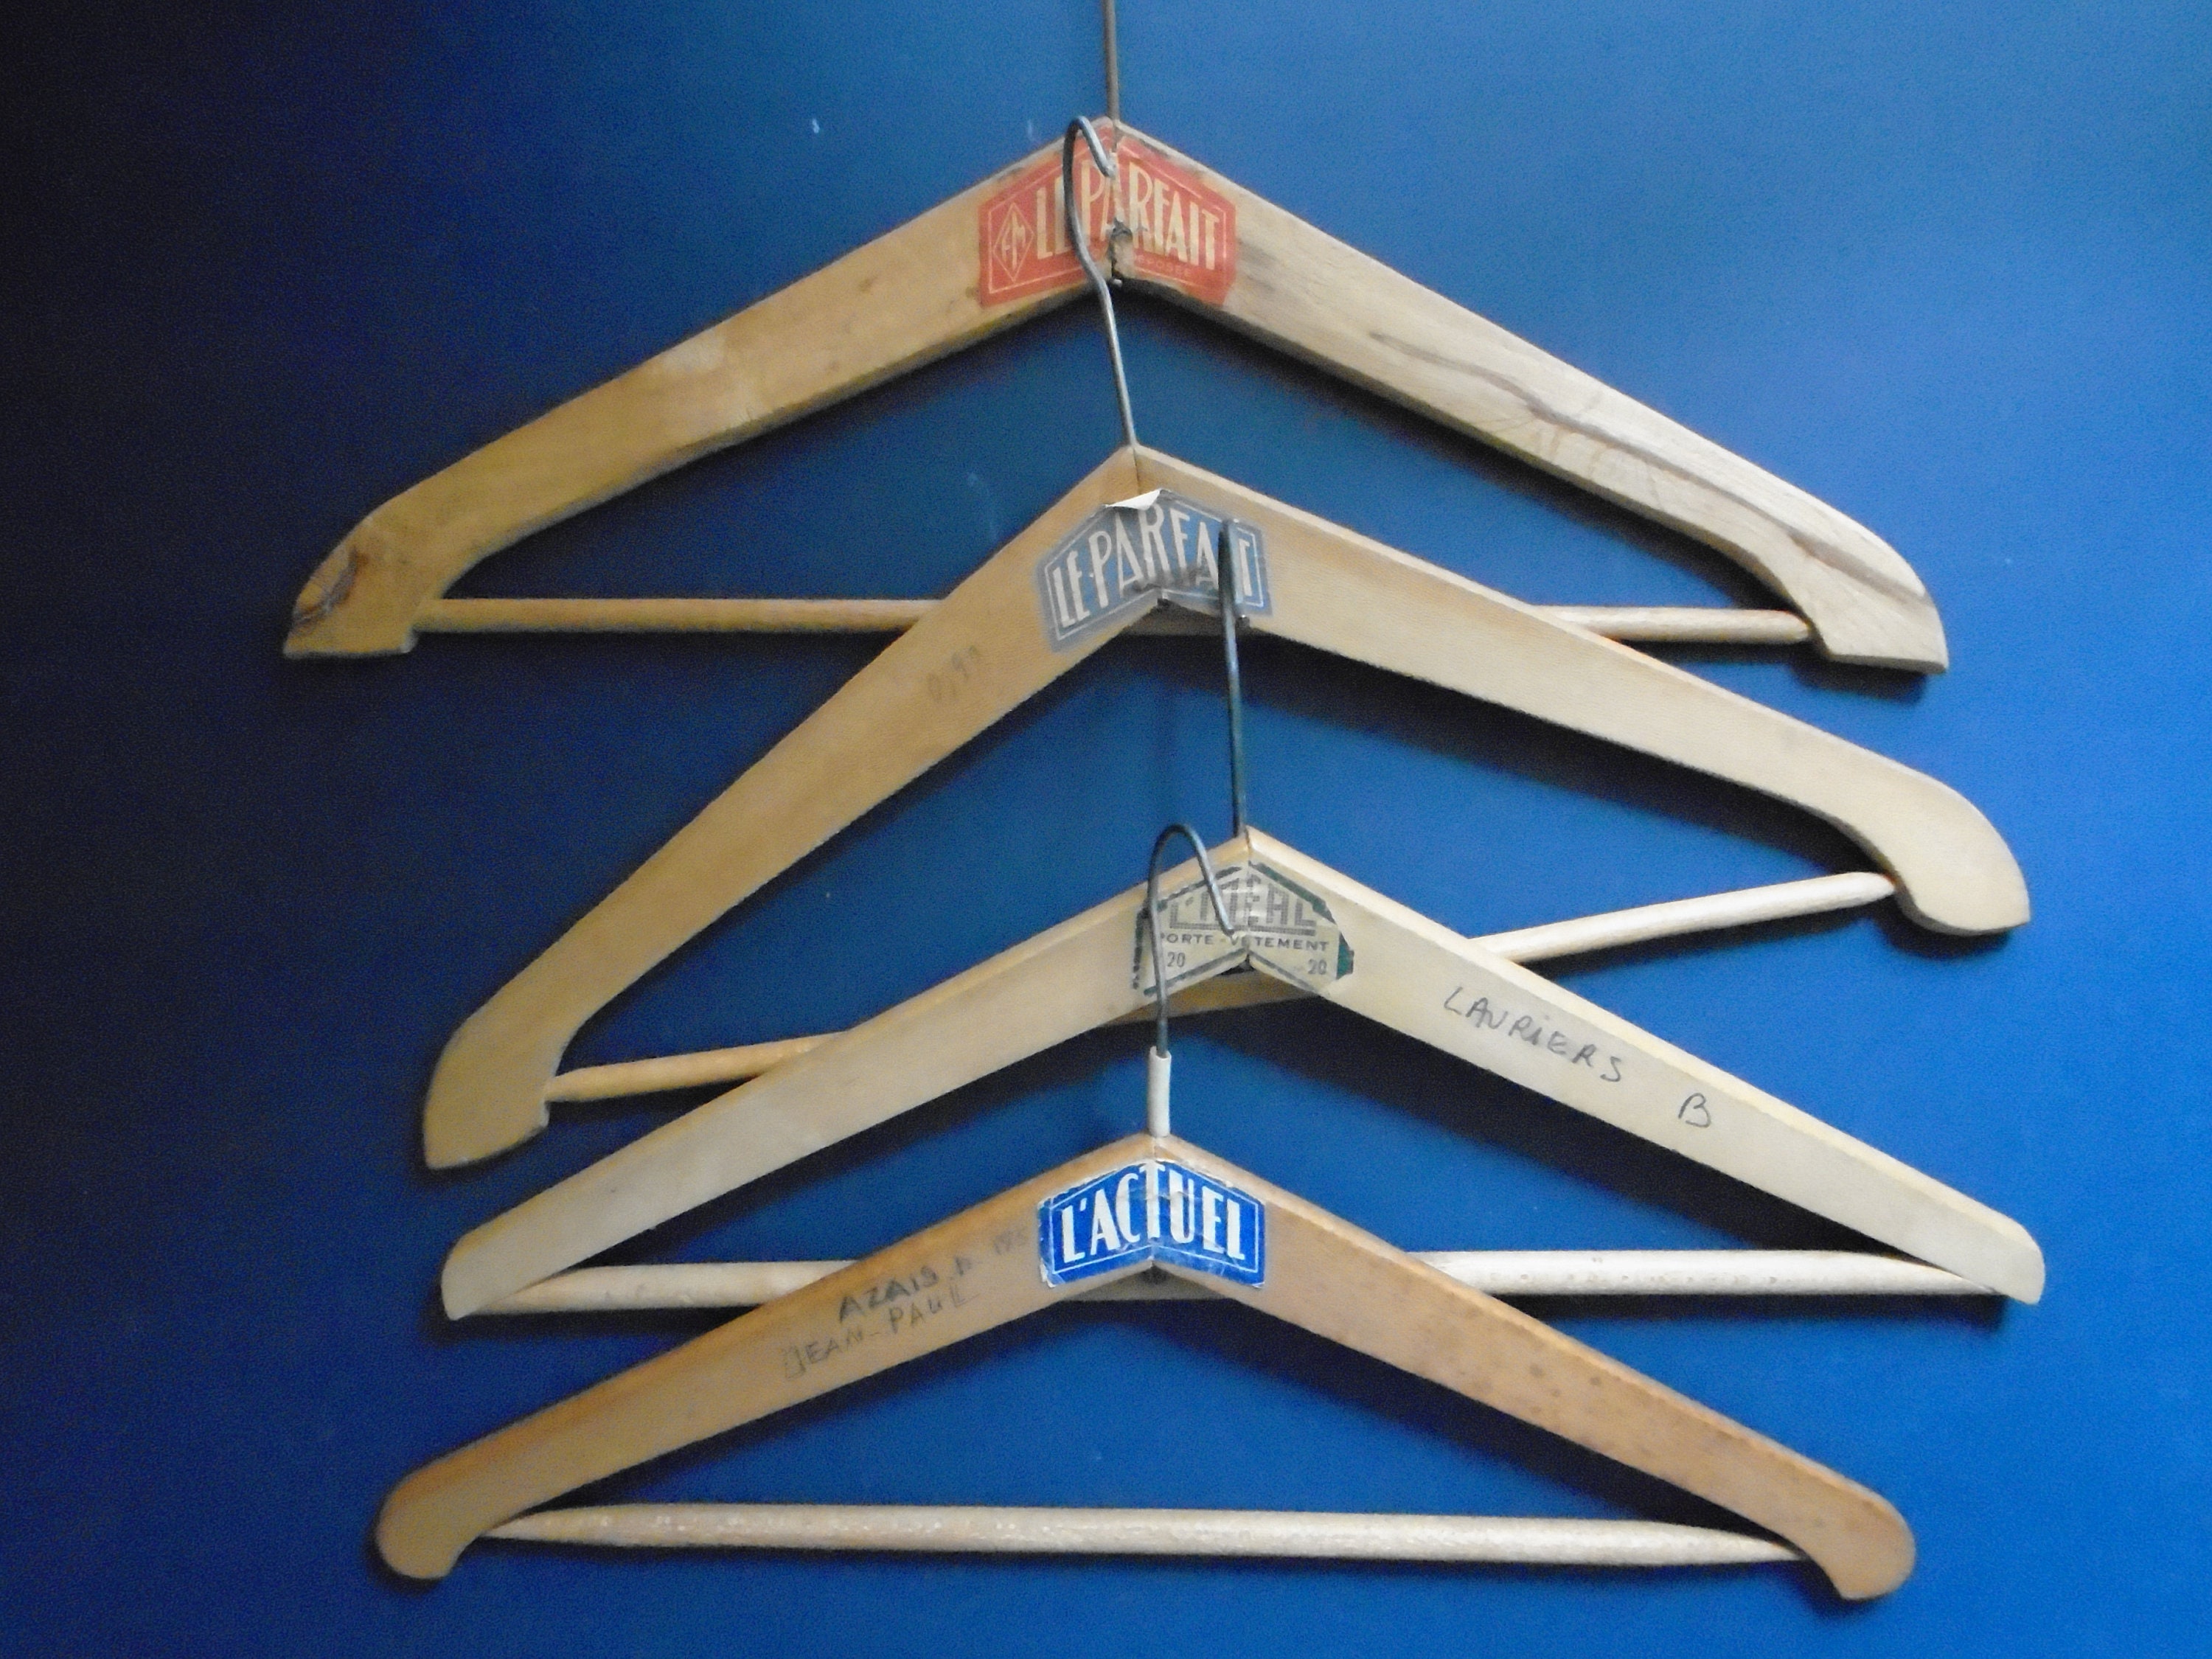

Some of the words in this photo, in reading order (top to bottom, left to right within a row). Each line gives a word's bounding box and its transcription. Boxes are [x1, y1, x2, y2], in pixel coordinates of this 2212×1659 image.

[1081, 153, 1220, 270] PARFAIT
[1053, 550, 1090, 628] LE
[1088, 503, 1251, 609] PARFAT
[1166, 951, 1186, 967] 20
[1307, 958, 1327, 975] 20
[1062, 1160, 1245, 1264] L'ACTUEL
